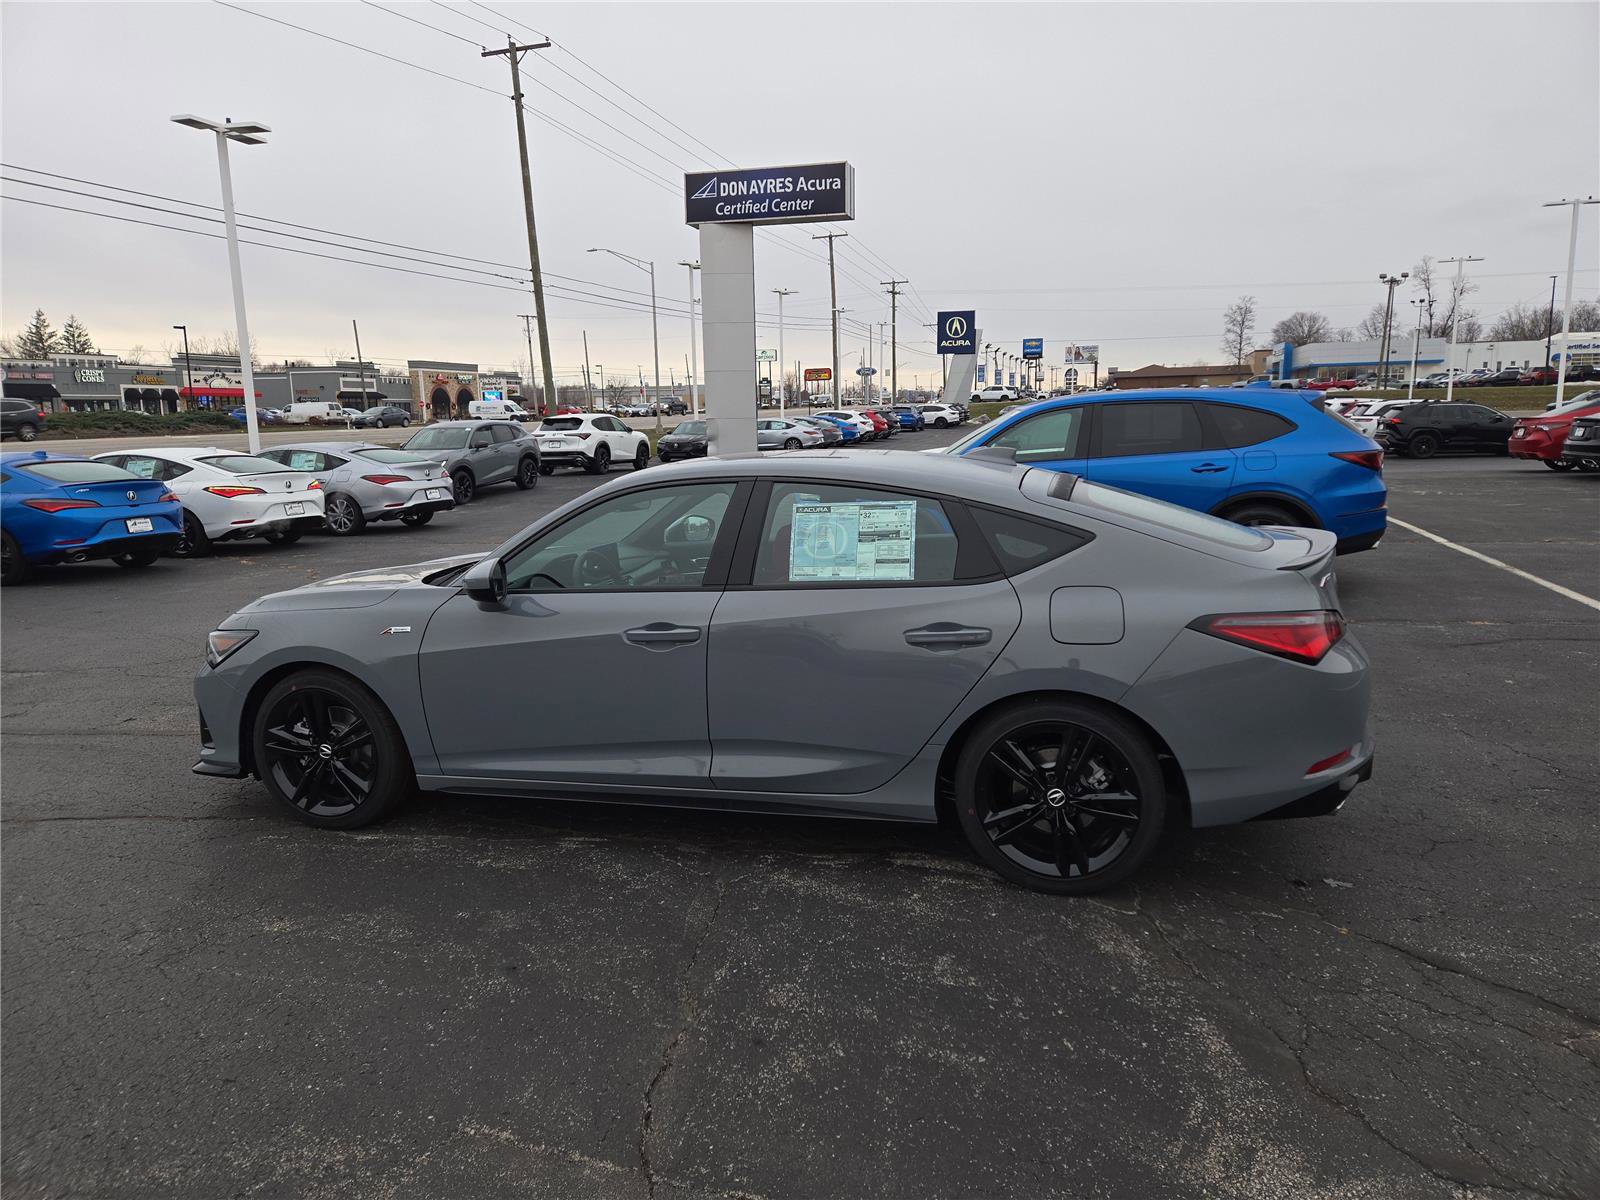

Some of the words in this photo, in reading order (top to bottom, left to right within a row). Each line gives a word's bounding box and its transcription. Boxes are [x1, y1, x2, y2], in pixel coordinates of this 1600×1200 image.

[720, 180, 747, 197] DON
[750, 177, 793, 194] AYRES
[796, 176, 841, 191] Acura
[715, 199, 769, 216] Certified
[771, 198, 815, 212] Center
[940, 339, 971, 347] ACURA
[863, 511, 872, 519] 32
